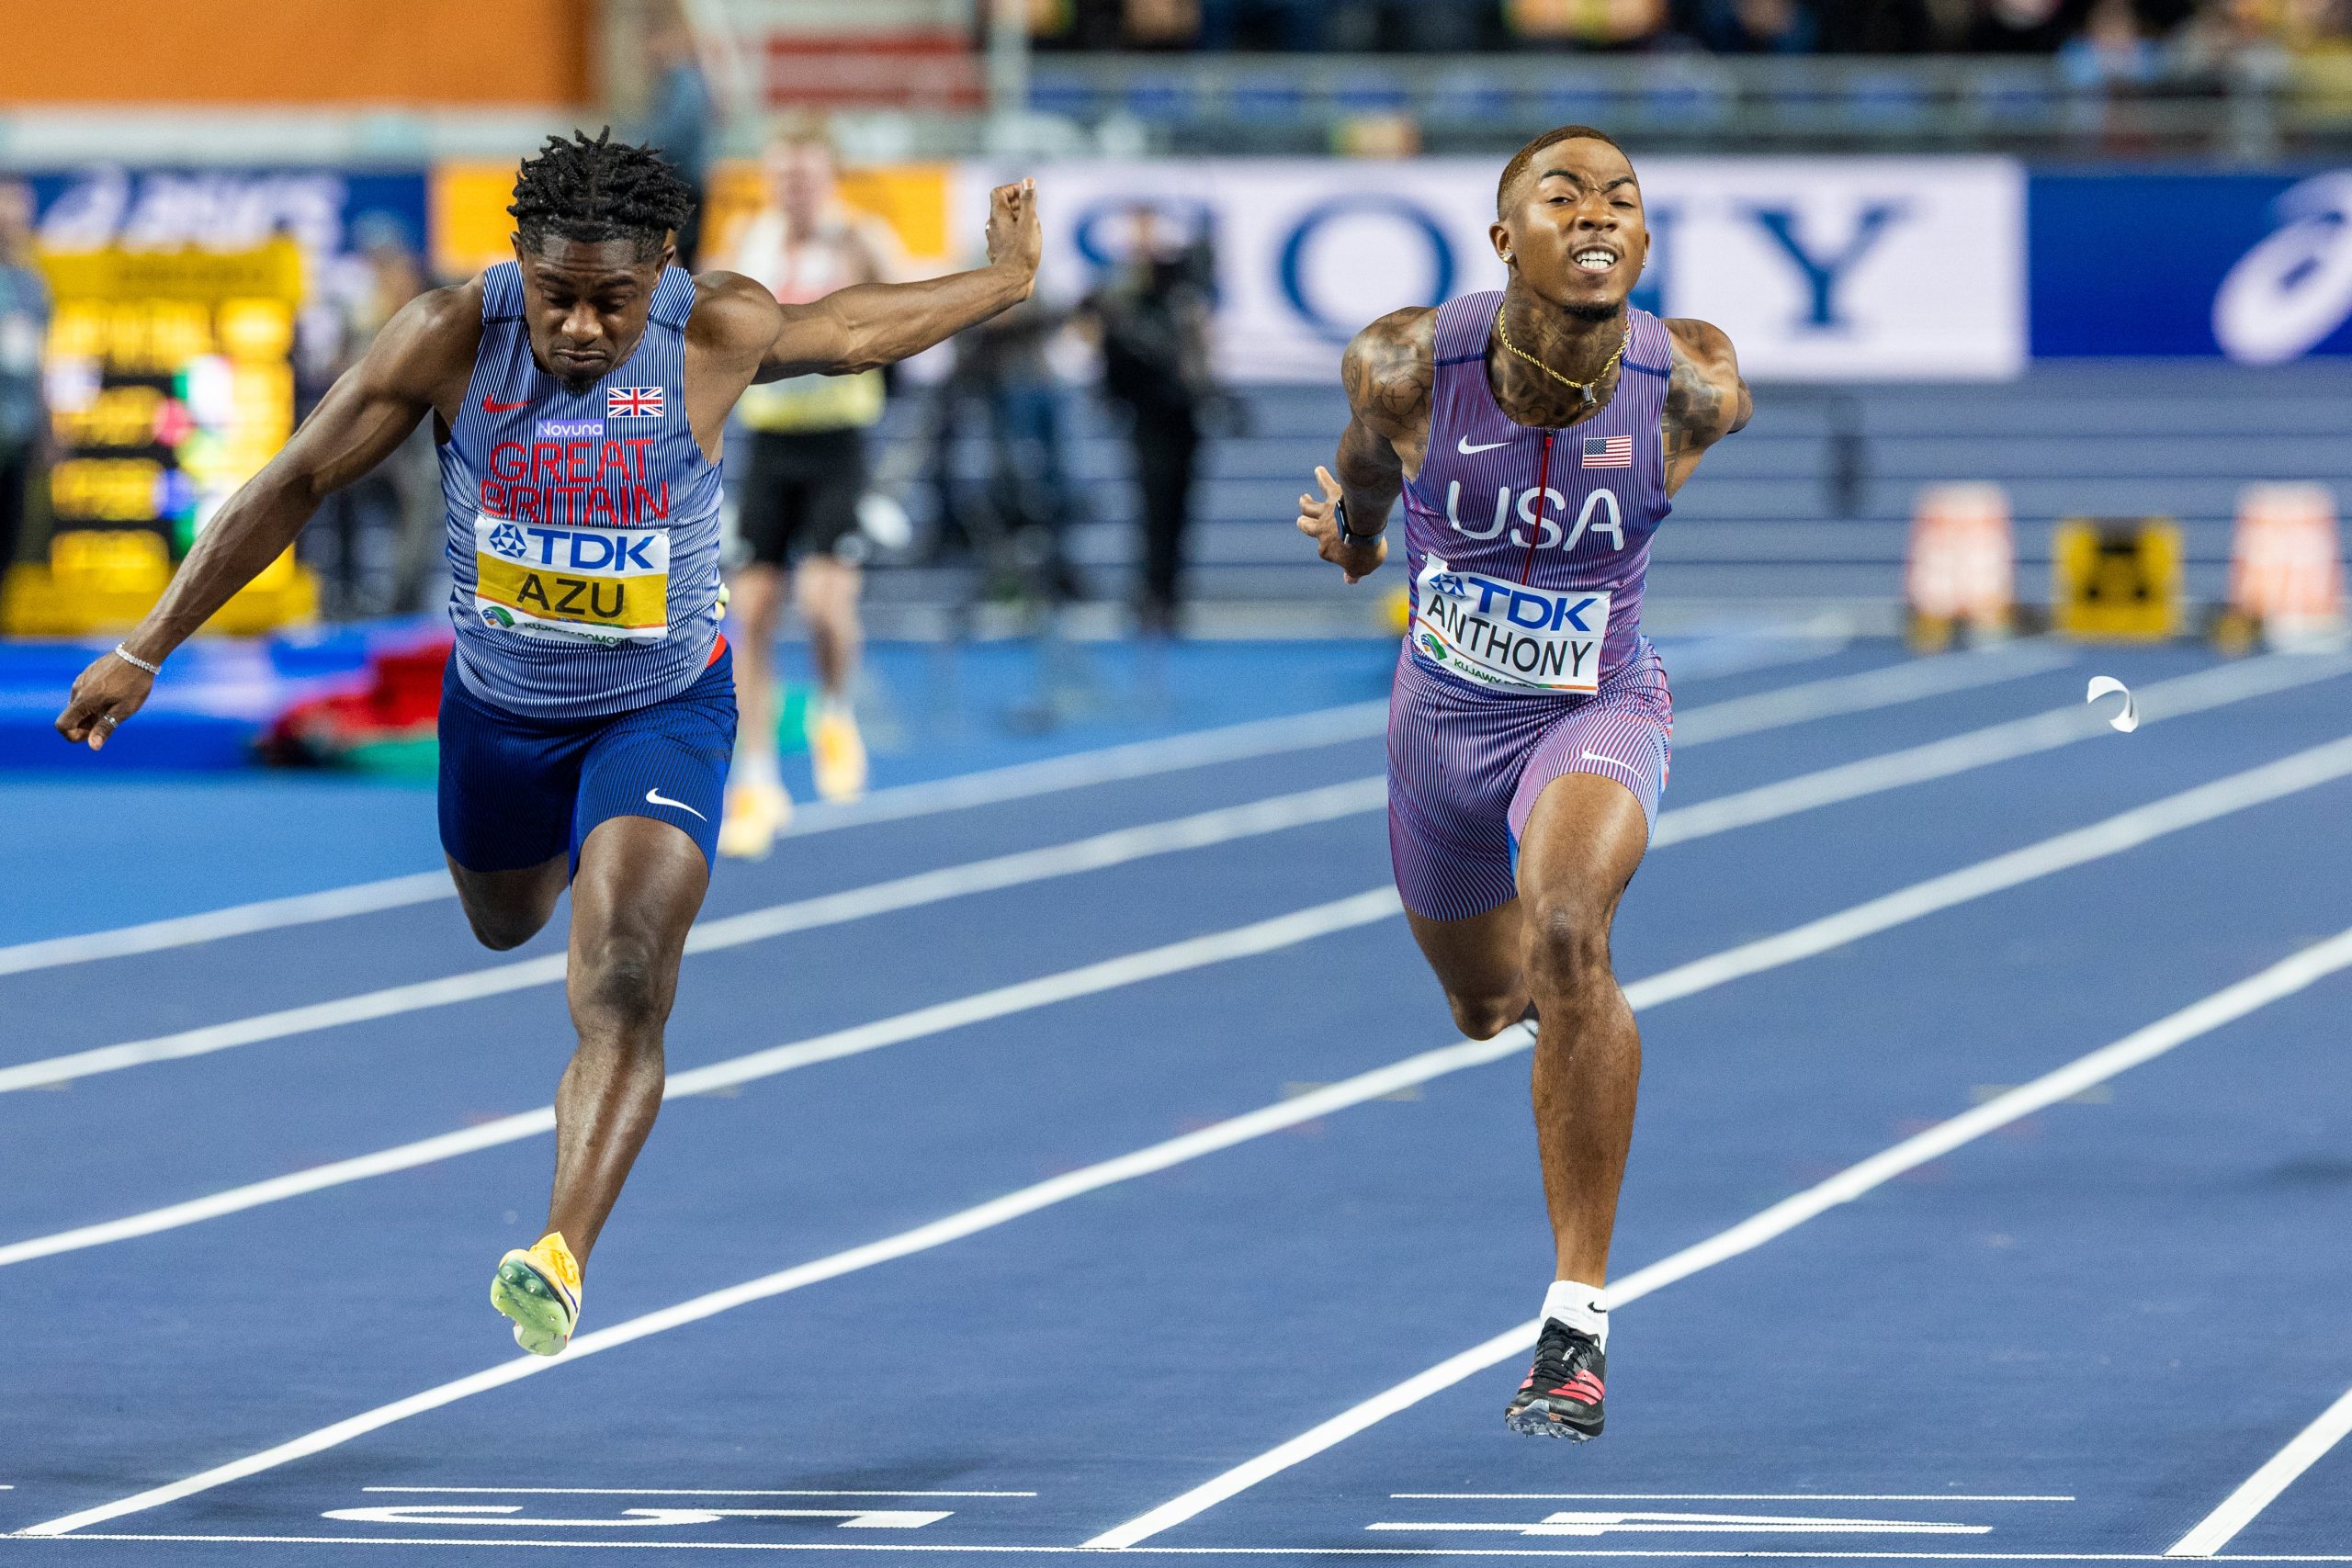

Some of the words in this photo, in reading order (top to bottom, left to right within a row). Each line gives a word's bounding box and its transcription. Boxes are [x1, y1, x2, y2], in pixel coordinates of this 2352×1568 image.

[1070, 193, 1909, 340] OY
[537, 421, 604, 437] Novuna
[490, 438, 654, 483] GREAT
[481, 478, 669, 525] BRITAIN
[1446, 480, 1625, 551] USA
[527, 527, 657, 571] TDK
[515, 573, 625, 619] AZU
[1468, 577, 1598, 632] TDK
[1427, 593, 1594, 678] ANTHONY
